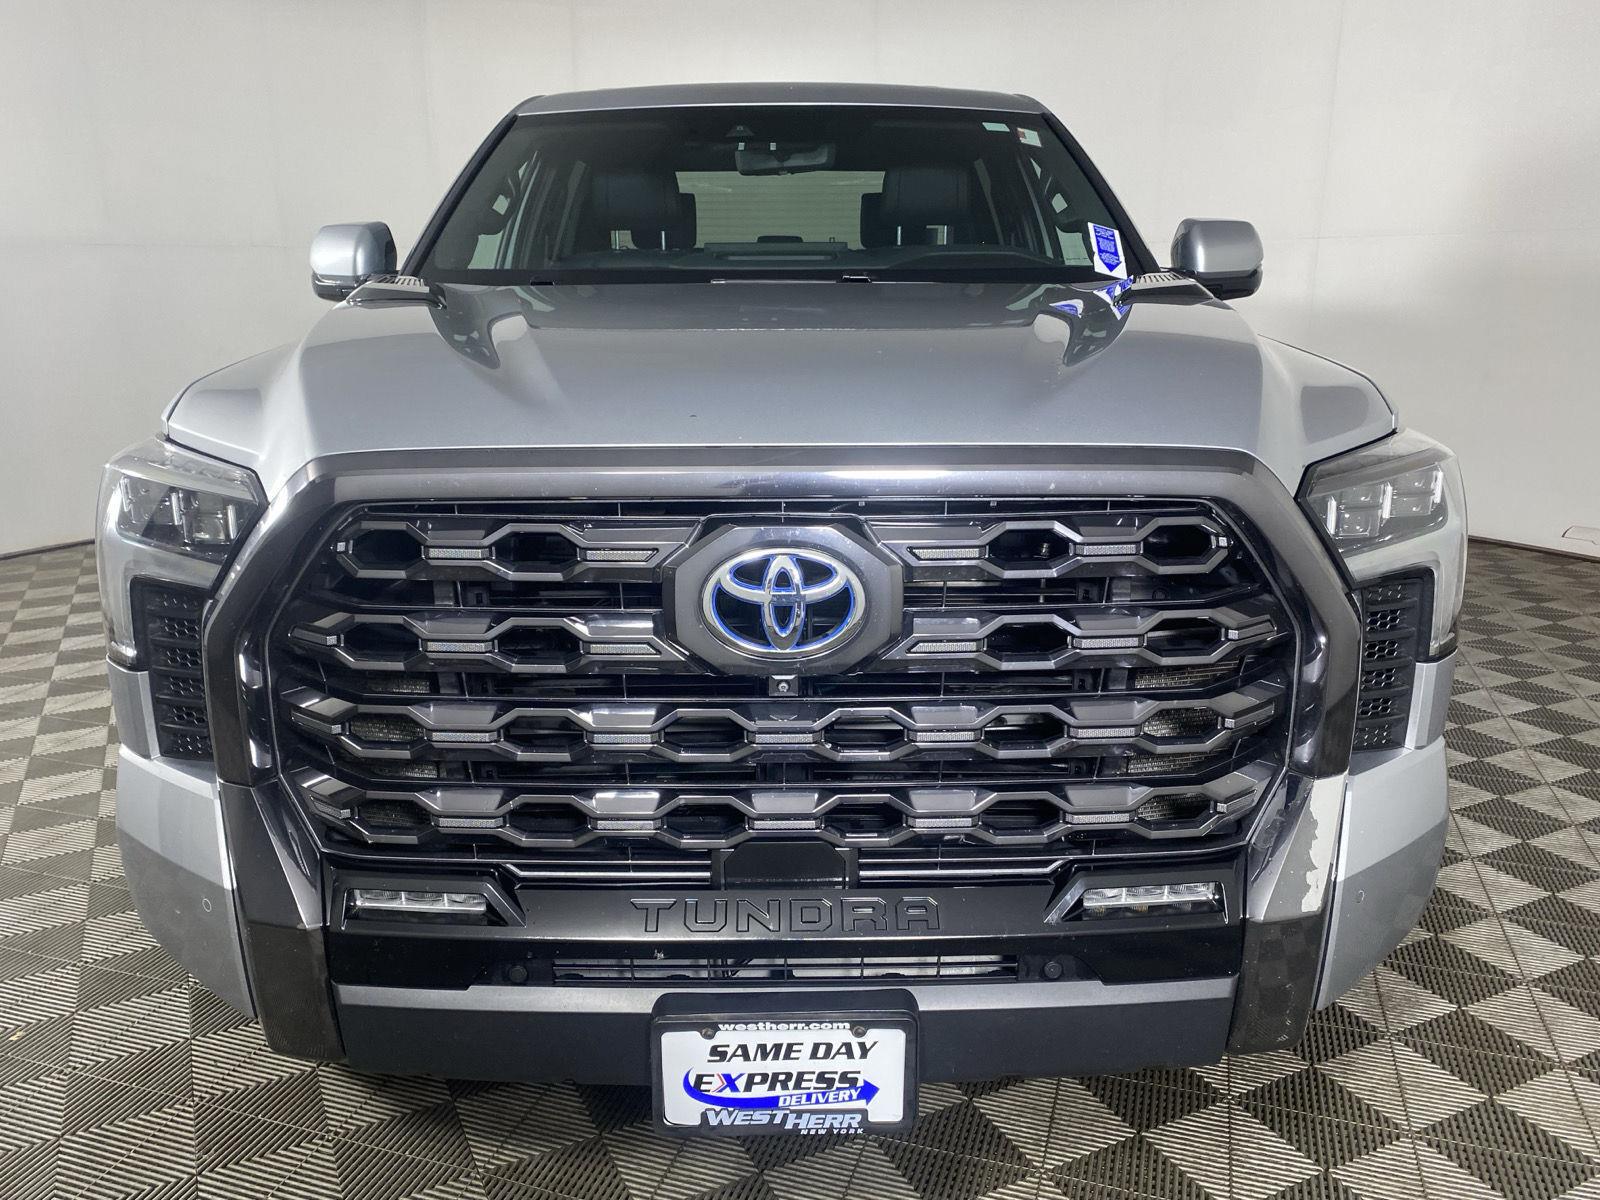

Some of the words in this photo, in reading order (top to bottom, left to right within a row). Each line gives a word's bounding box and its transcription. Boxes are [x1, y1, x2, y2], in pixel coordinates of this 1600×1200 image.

[630, 897, 940, 932] TUNDRA
[718, 1022, 850, 1031] westherr.com
[707, 1042, 803, 1062] SAME
[808, 1041, 879, 1060] DAY
[693, 1071, 861, 1093] EXPRESS
[778, 1087, 862, 1107] DELIVERY
[831, 1127, 864, 1135] YORK
